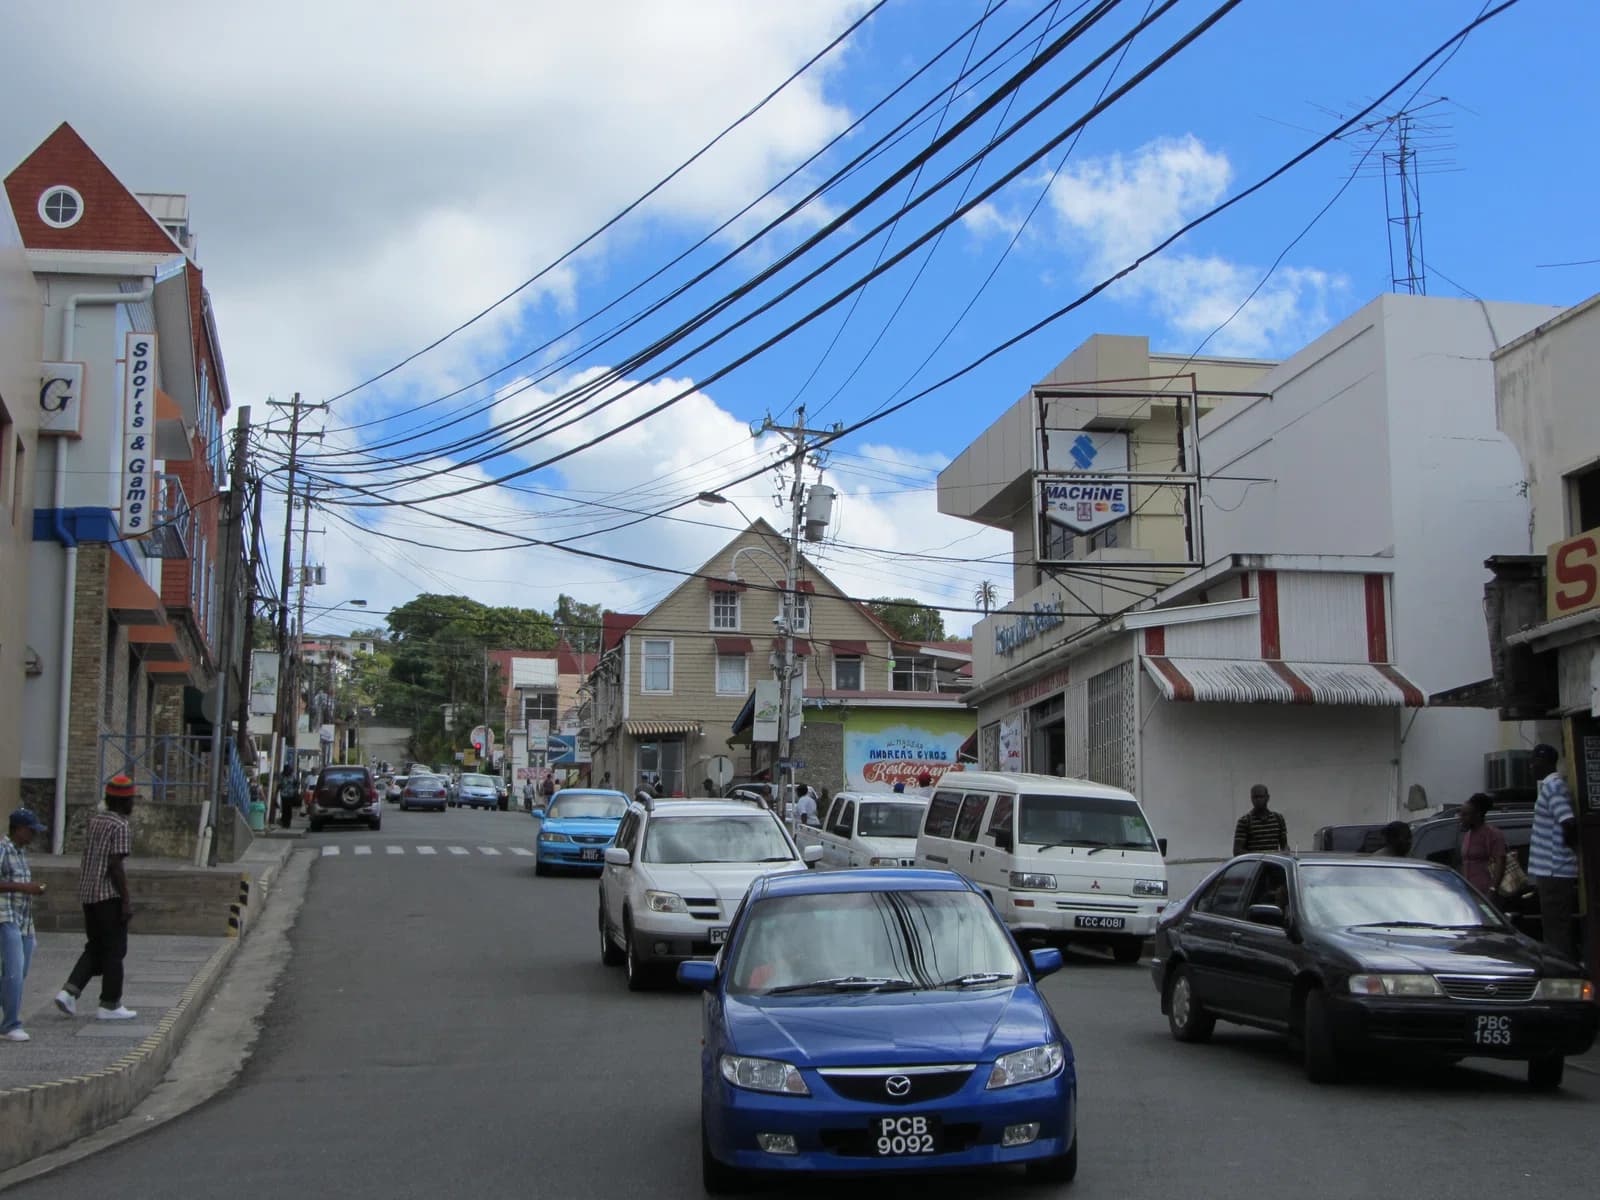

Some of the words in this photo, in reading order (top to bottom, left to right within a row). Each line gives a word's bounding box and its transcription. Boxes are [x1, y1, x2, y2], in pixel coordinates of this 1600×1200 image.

[132, 342, 149, 428] Sports
[131, 436, 145, 451] &
[127, 458, 146, 528] Games
[1079, 916, 1098, 927] TCC
[1100, 917, 1122, 928] 4081
[1477, 1015, 1509, 1030] PBC
[1474, 1030, 1511, 1044] 1553
[882, 1116, 928, 1136] PCB
[877, 1134, 935, 1154] 9092
